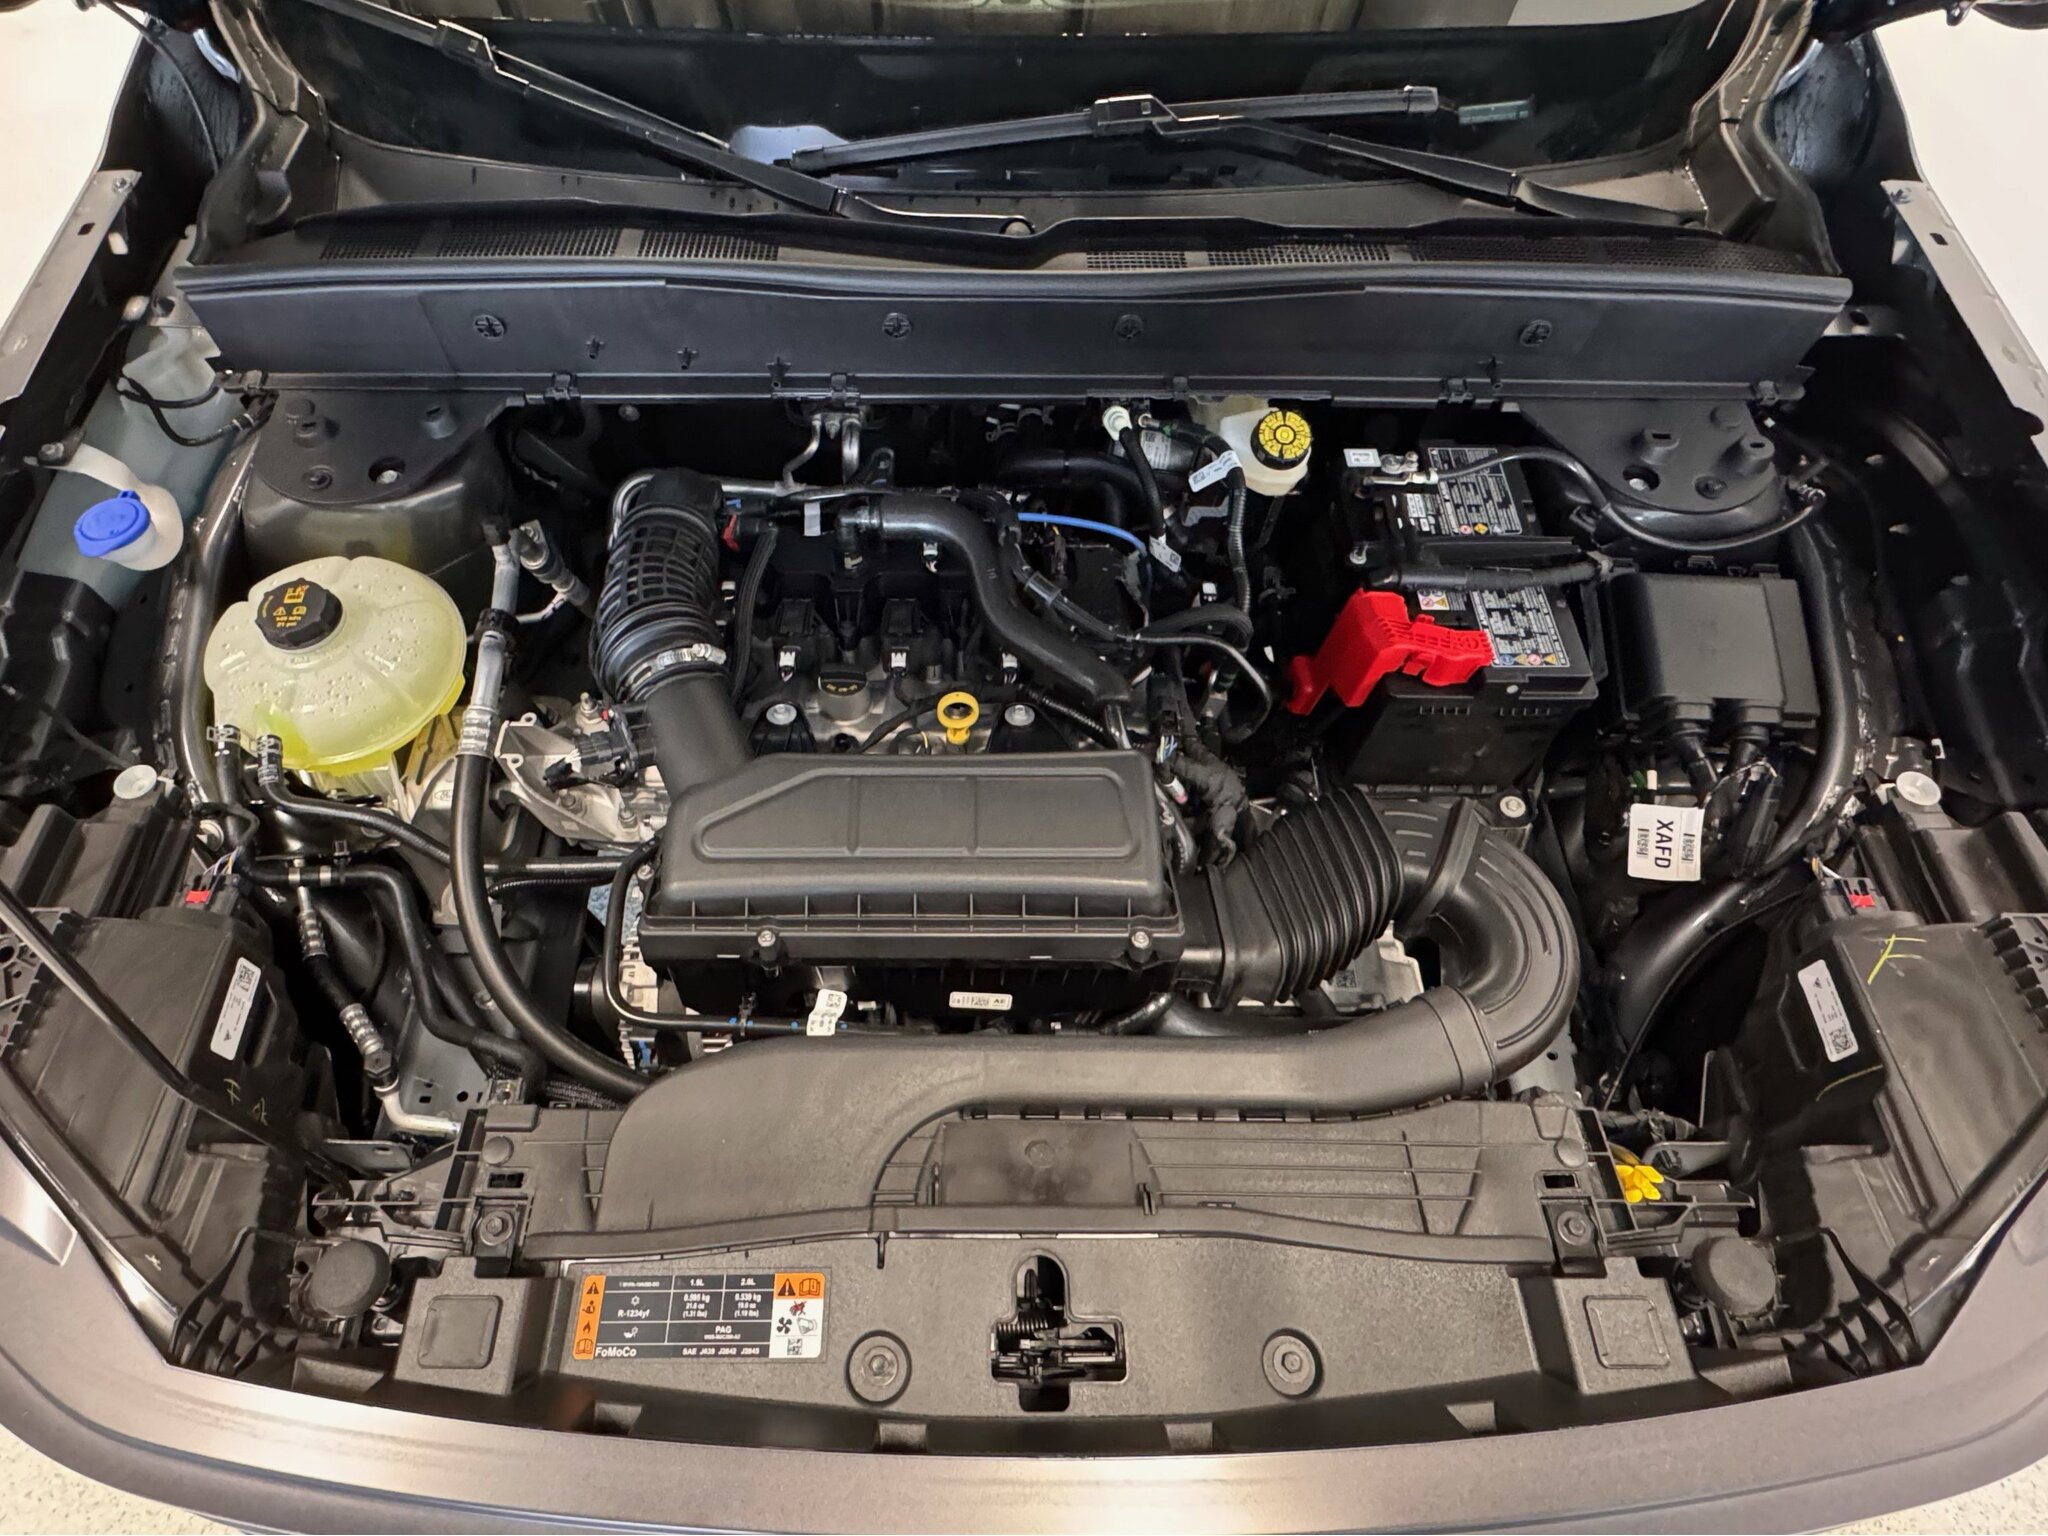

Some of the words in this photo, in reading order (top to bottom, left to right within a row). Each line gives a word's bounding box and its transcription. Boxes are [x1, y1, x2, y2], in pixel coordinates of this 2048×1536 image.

[1654, 819, 1674, 869] XAFD
[701, 1293, 711, 1303] kg
[753, 1292, 762, 1303] kg
[617, 1309, 651, 1319] R-1234yf
[715, 1325, 732, 1334] PAG
[595, 1346, 637, 1357] FoMoCo
[682, 1347, 697, 1355] SAE
